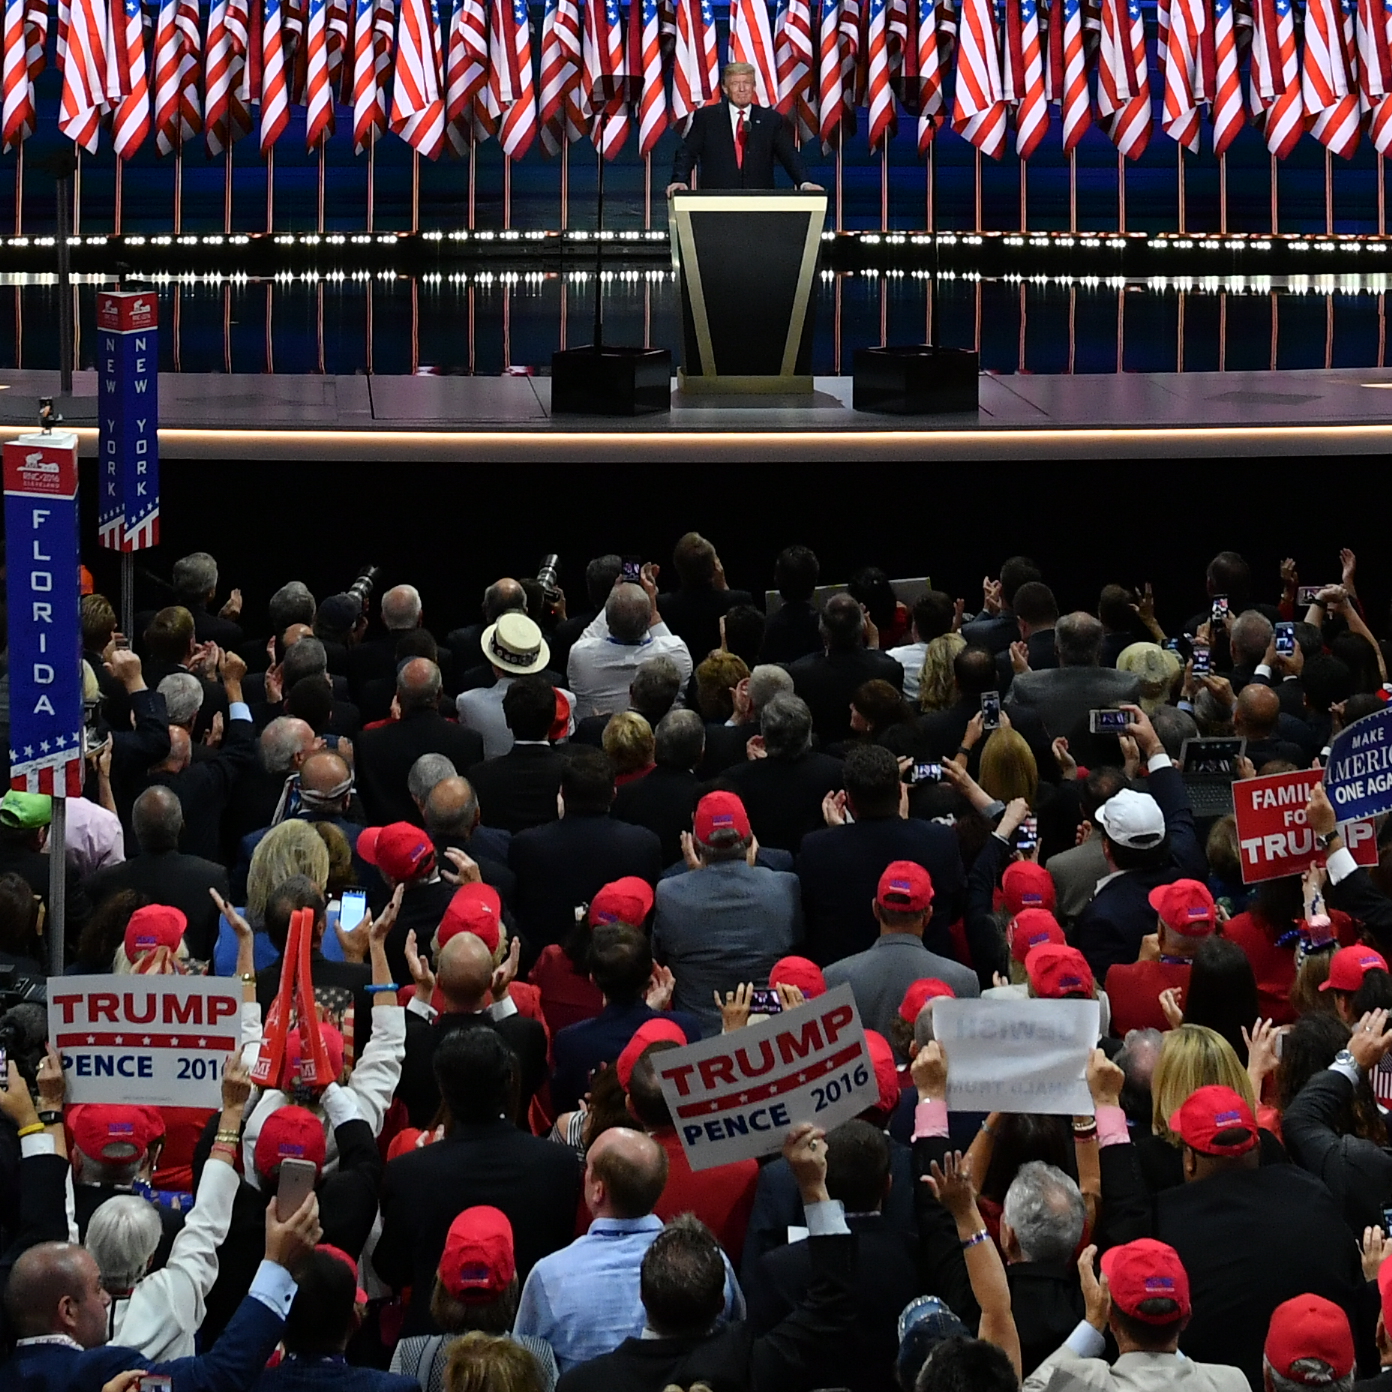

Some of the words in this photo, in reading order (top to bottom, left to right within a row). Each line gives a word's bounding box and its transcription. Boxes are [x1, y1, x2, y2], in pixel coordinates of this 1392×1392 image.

[105, 337, 117, 394] NEW
[134, 337, 148, 394] NEW
[106, 418, 117, 497] YORK
[137, 418, 149, 497] YORK
[30, 509, 56, 716] FLORIDA
[1351, 726, 1385, 749] MAKE
[1335, 780, 1365, 805] ONE
[1240, 823, 1373, 865] TRUP
[53, 992, 237, 1026] TRUMP
[177, 1058, 224, 1080] 201
[661, 1004, 855, 1098] TRUMP
[683, 1103, 790, 1146] PENCE
[811, 1064, 869, 1113] 2016
